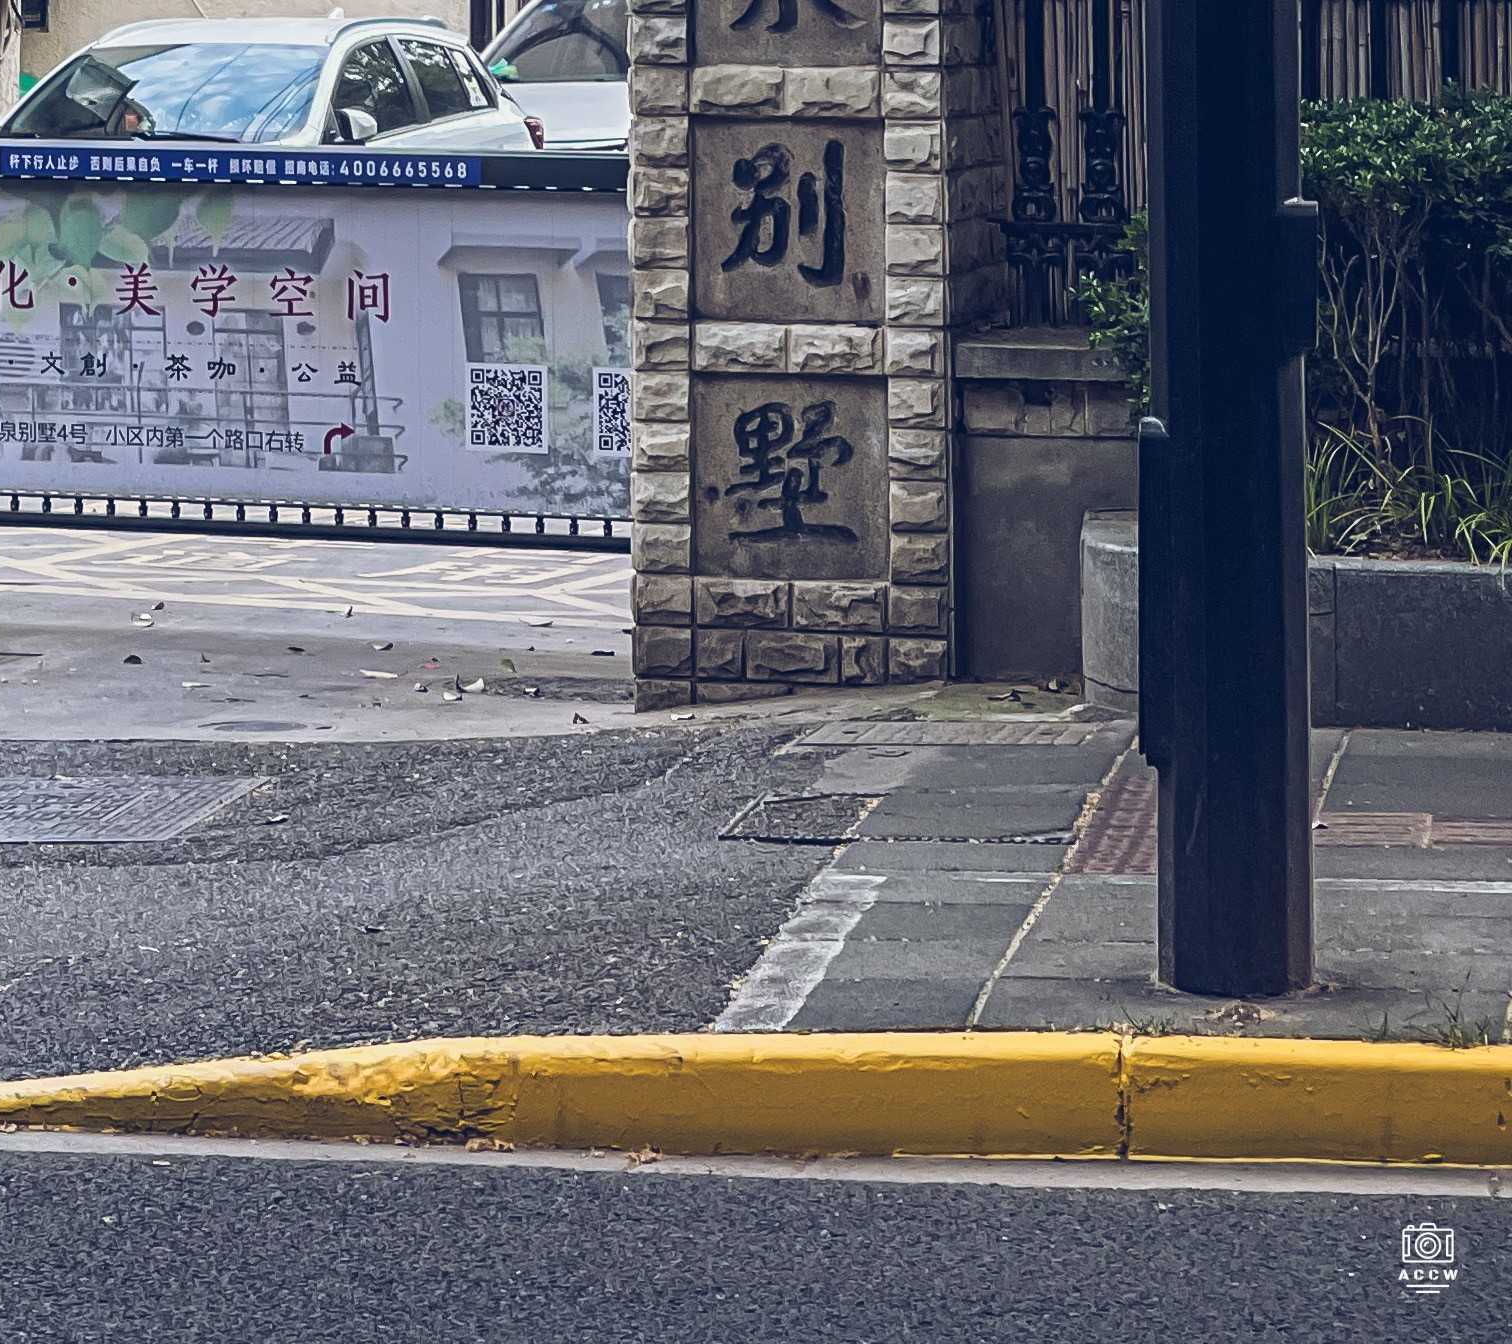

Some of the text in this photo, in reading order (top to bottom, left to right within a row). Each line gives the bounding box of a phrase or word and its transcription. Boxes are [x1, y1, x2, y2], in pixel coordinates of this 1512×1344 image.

[9, 153, 80, 171] 杆下行人止步
[89, 155, 162, 173] 否则后果自负
[171, 157, 219, 174] 一车一杆
[104, 424, 306, 455] 小区内第一个路口右转
